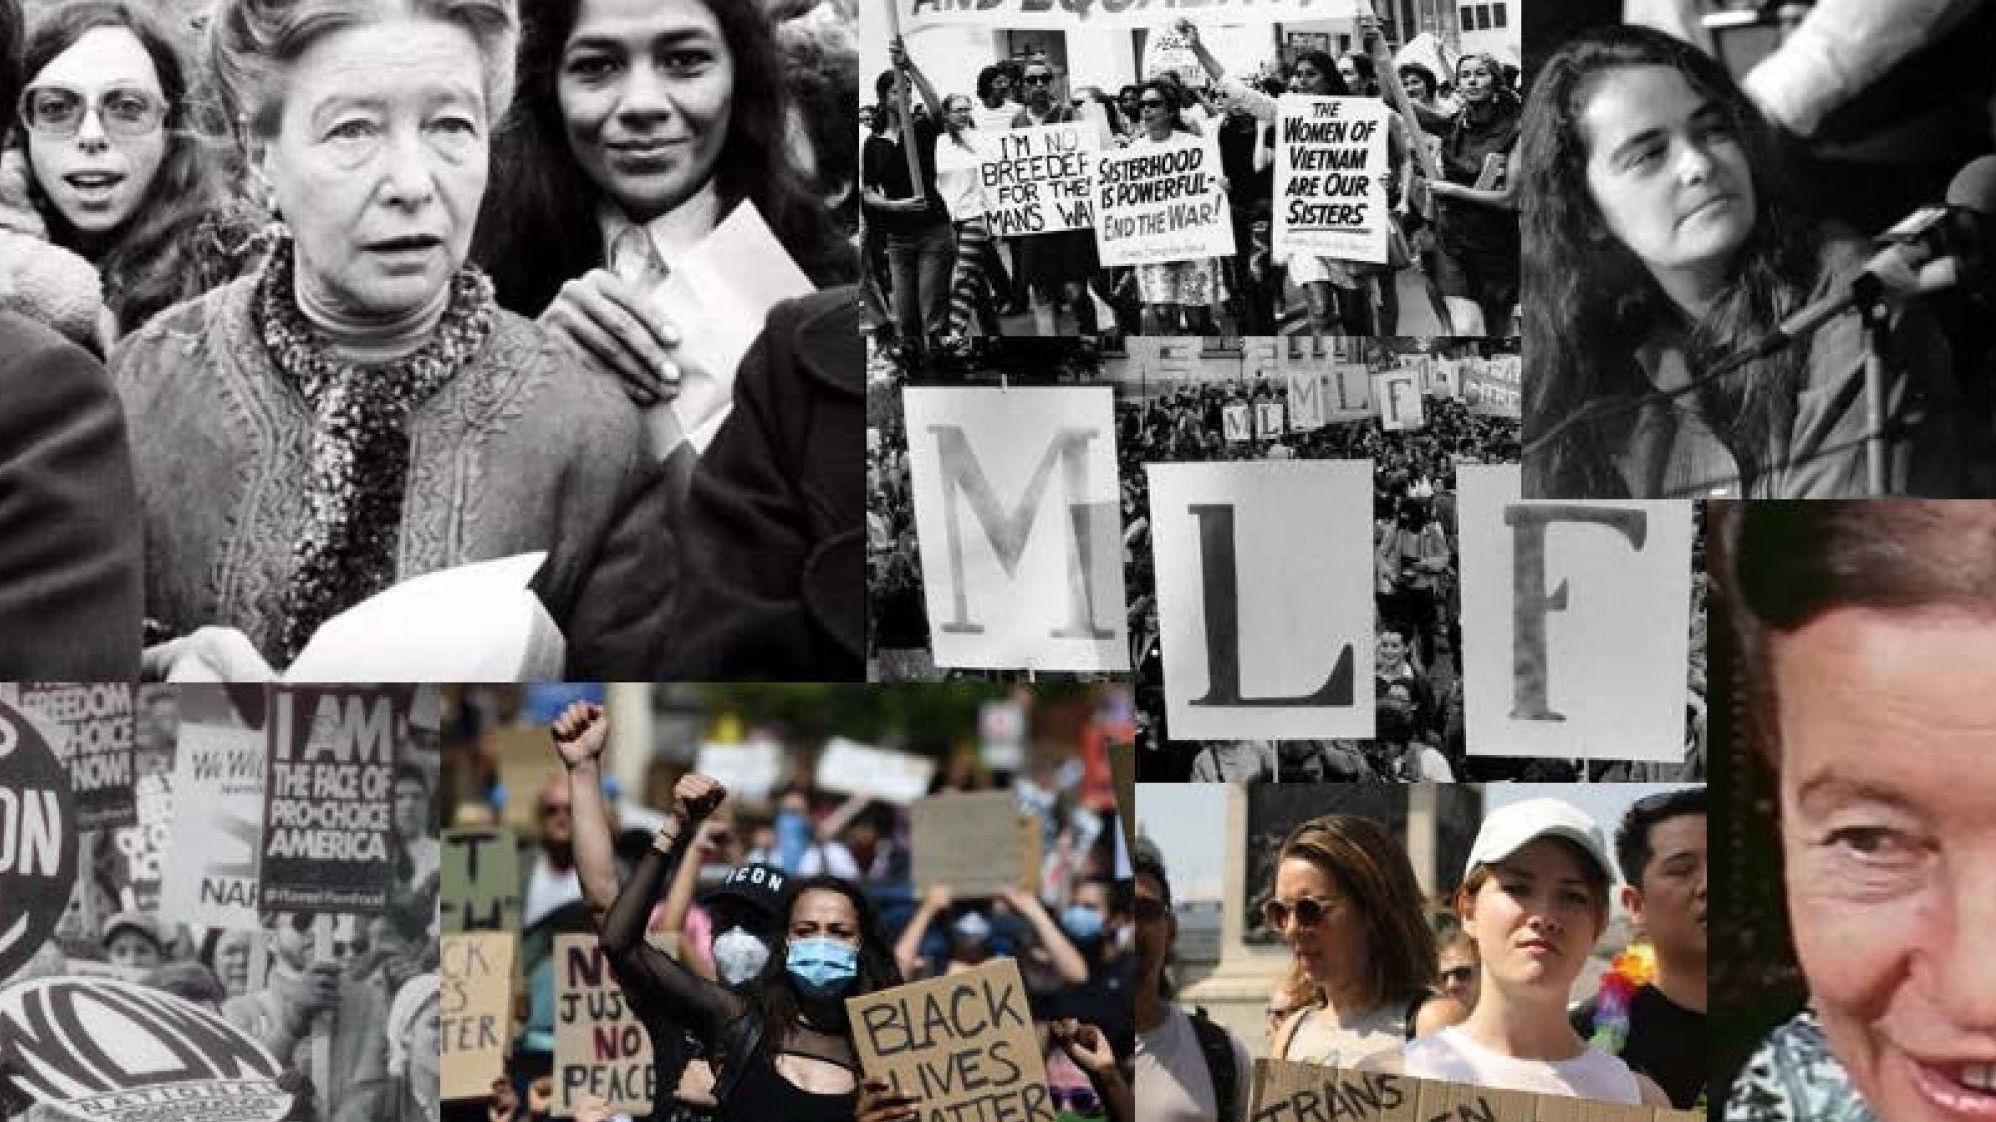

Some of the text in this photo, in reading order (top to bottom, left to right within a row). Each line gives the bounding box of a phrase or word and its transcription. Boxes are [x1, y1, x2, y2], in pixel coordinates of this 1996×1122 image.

[1311, 102, 1342, 118] THE
[1284, 116, 1378, 144] WOMEN OF
[1098, 148, 1203, 186] SISTERHOOD
[1289, 146, 1368, 171] VIETNAM
[999, 182, 1040, 203] FOR
[1284, 173, 1369, 196] ARE OUR
[1104, 193, 1220, 241] END THE WAR!
[1285, 199, 1369, 225] SISTERS
[926, 426, 1116, 641] M
[1188, 503, 1355, 708] L
[1504, 503, 1648, 721] F
[276, 692, 393, 763] I AM
[70, 752, 130, 792] NOW!
[276, 763, 393, 800] THE FACE OF
[270, 799, 391, 830] PRO-CHOICE
[266, 830, 387, 862] AMERICA
[861, 979, 1025, 1058] BLACK
[593, 1024, 643, 1062] NO
[886, 1040, 1021, 1103] LIVES
[1251, 1072, 1402, 1122] TRANS
